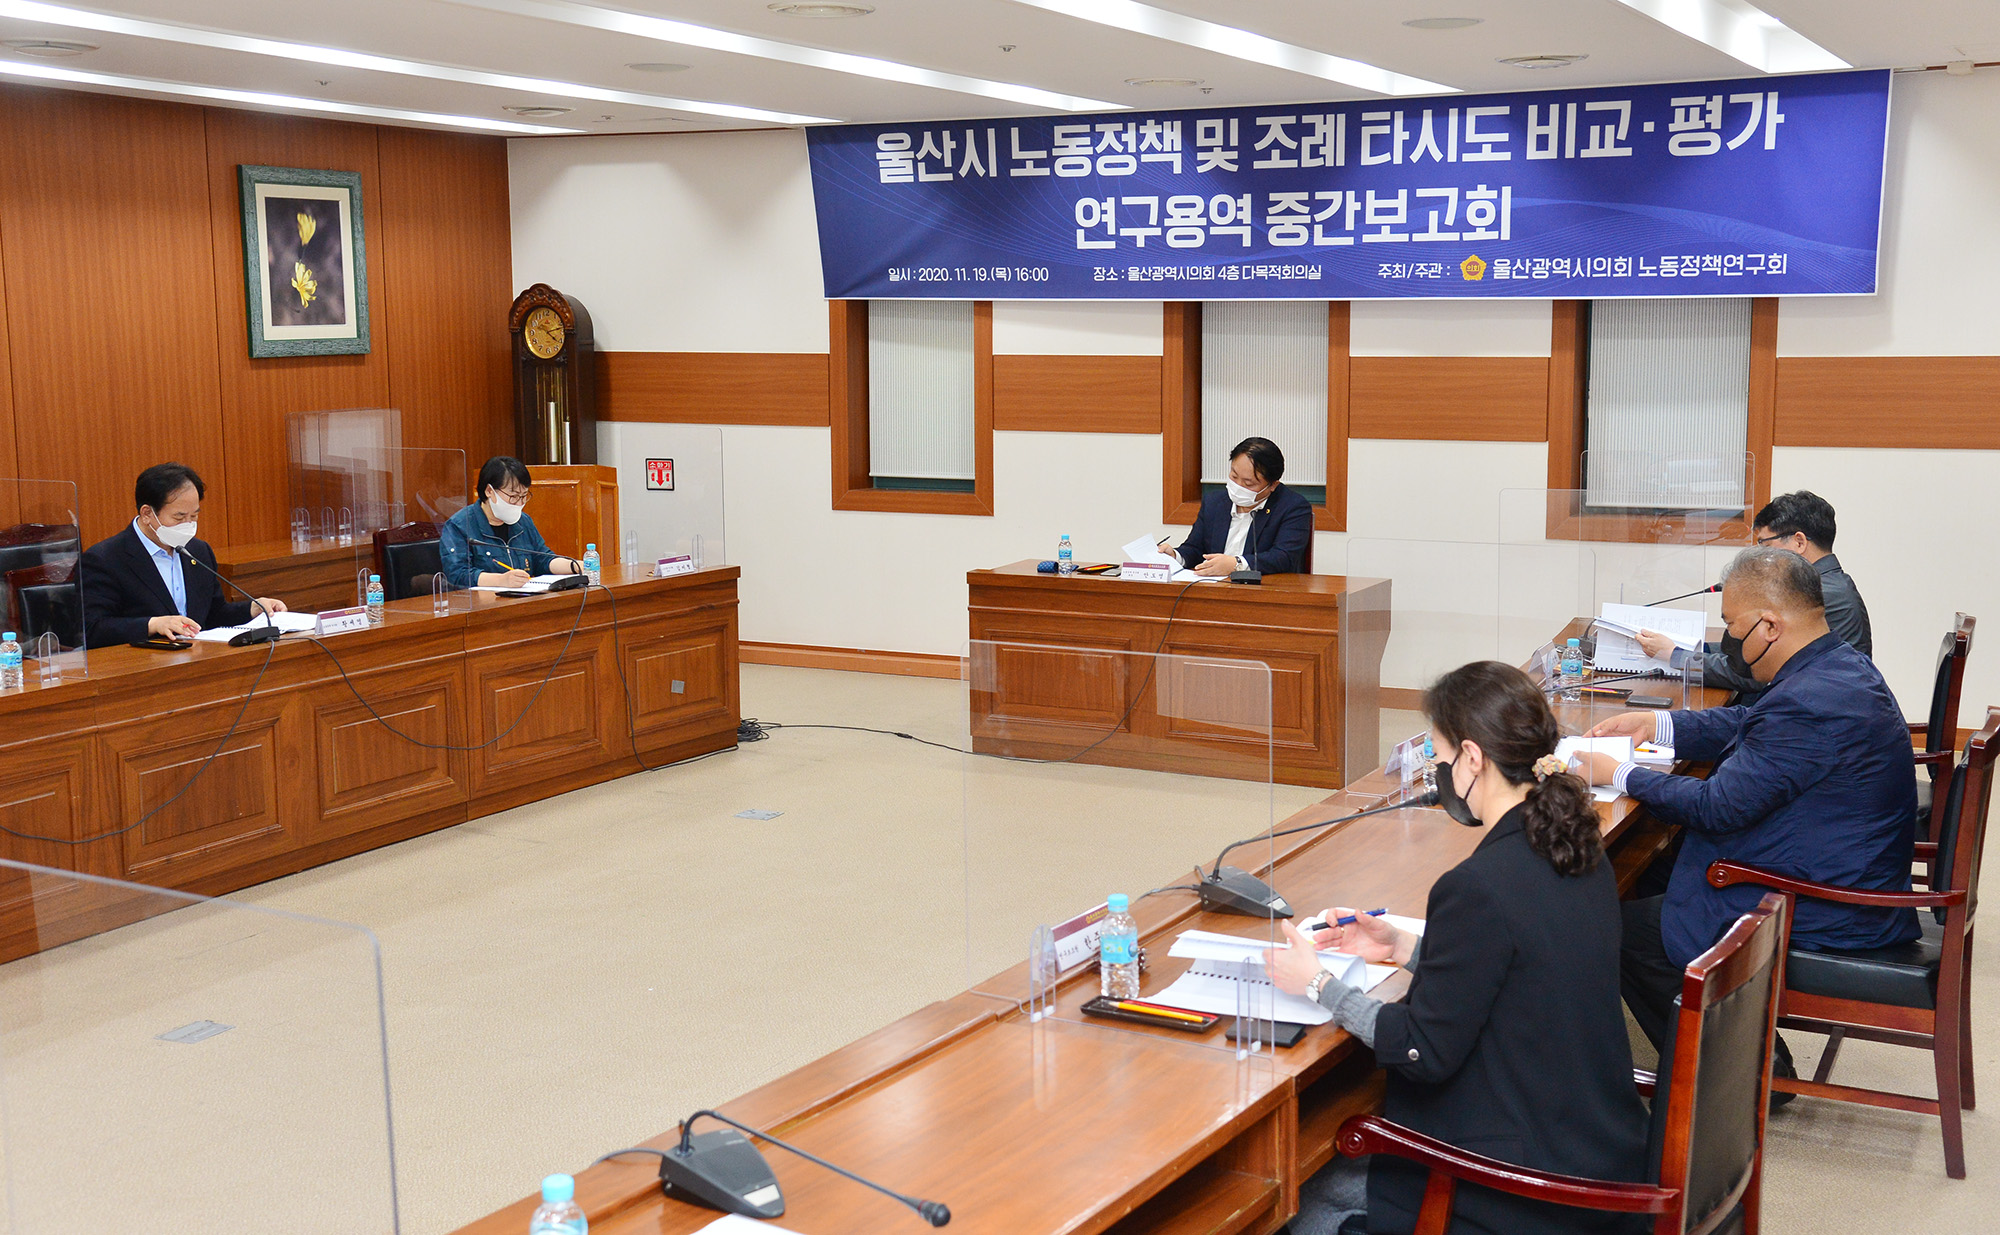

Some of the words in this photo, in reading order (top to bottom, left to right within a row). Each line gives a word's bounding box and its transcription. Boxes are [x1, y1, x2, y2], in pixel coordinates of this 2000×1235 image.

[876, 127, 998, 184] 울산시
[1010, 119, 1182, 178] 노동정책
[1196, 118, 1239, 174] 및
[1254, 113, 1346, 170] 조례
[1360, 105, 1512, 166] 타시도
[1075, 193, 1252, 250] 연구용역
[1266, 184, 1512, 247] 중간보고회
[888, 267, 911, 282] 일시
[918, 267, 953, 282] 2020.
[955, 267, 971, 281] 11.
[972, 266, 1012, 282] 19.(목)
[1014, 267, 1049, 282] 16:00
[1093, 266, 1119, 282] 장소
[1127, 265, 1215, 282] 울산광역시의회
[1217, 264, 1240, 281] 4층
[1242, 264, 1322, 281] 다목적회의실
[1378, 262, 1444, 279] 주최/주관
[1492, 255, 1633, 280] 울산광역시의회
[1637, 253, 1788, 278] 노동정책연구회
[649, 461, 671, 469] 소화기
